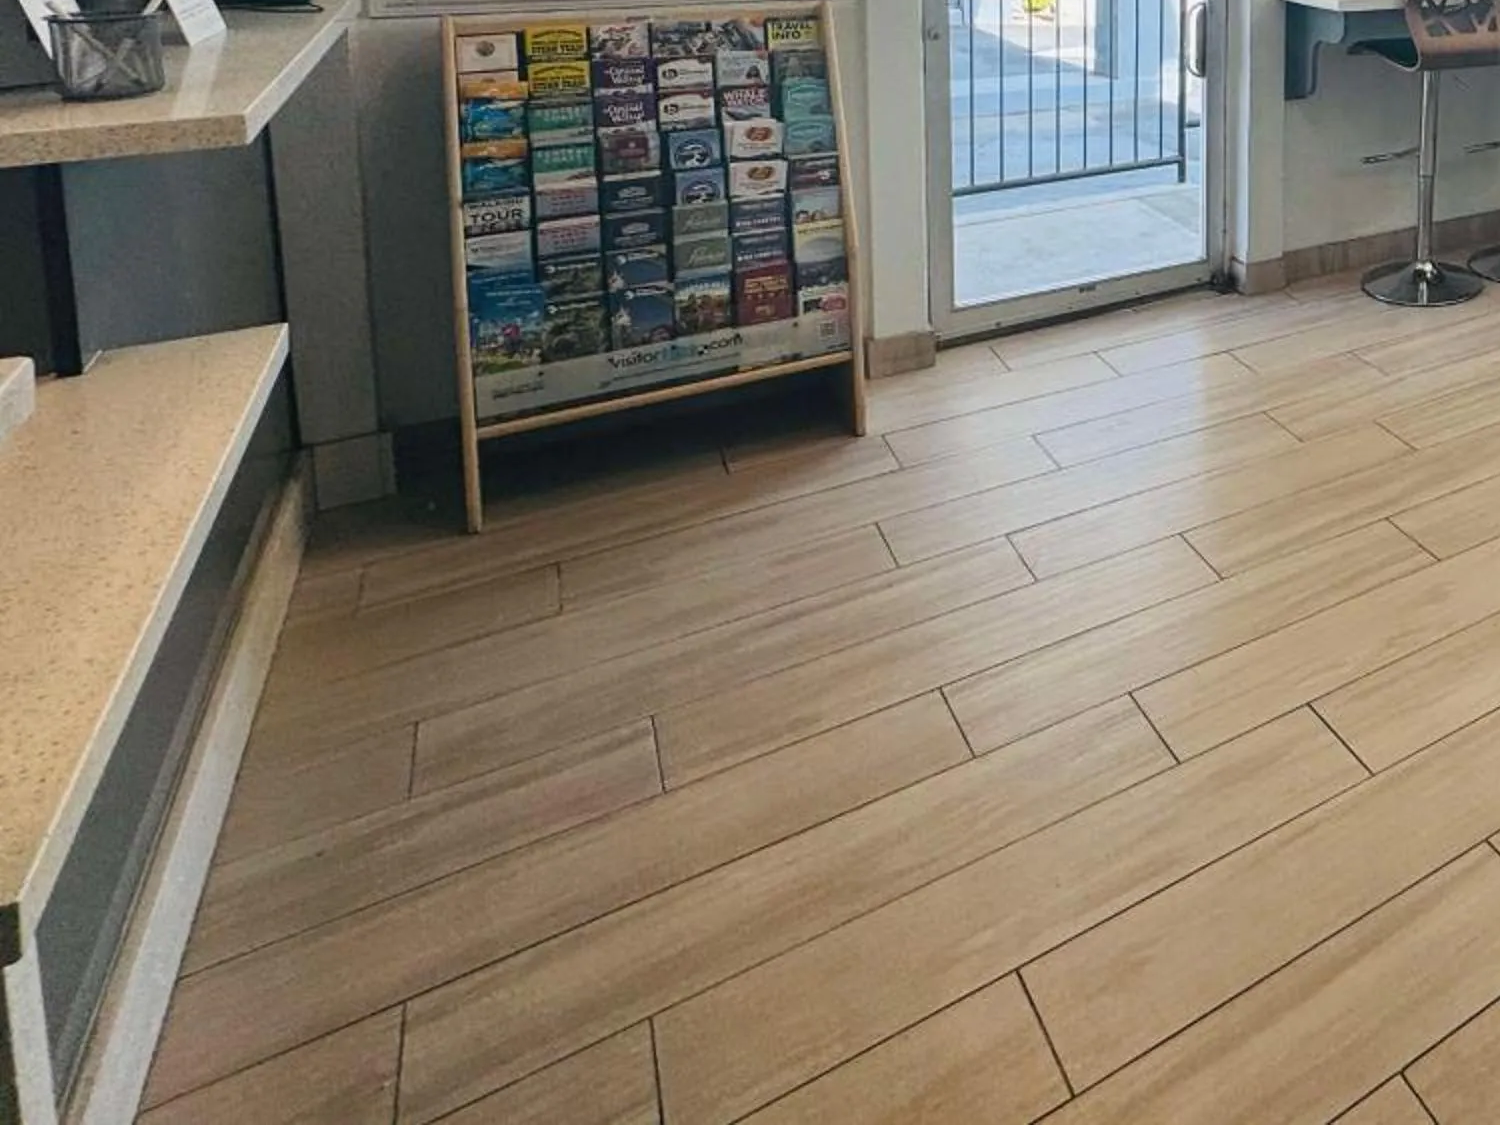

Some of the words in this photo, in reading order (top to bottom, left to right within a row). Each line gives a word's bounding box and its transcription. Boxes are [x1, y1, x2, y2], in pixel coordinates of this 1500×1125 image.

[771, 30, 802, 41] INFO
[723, 88, 767, 101] WHALE
[469, 208, 524, 224] TOUR
